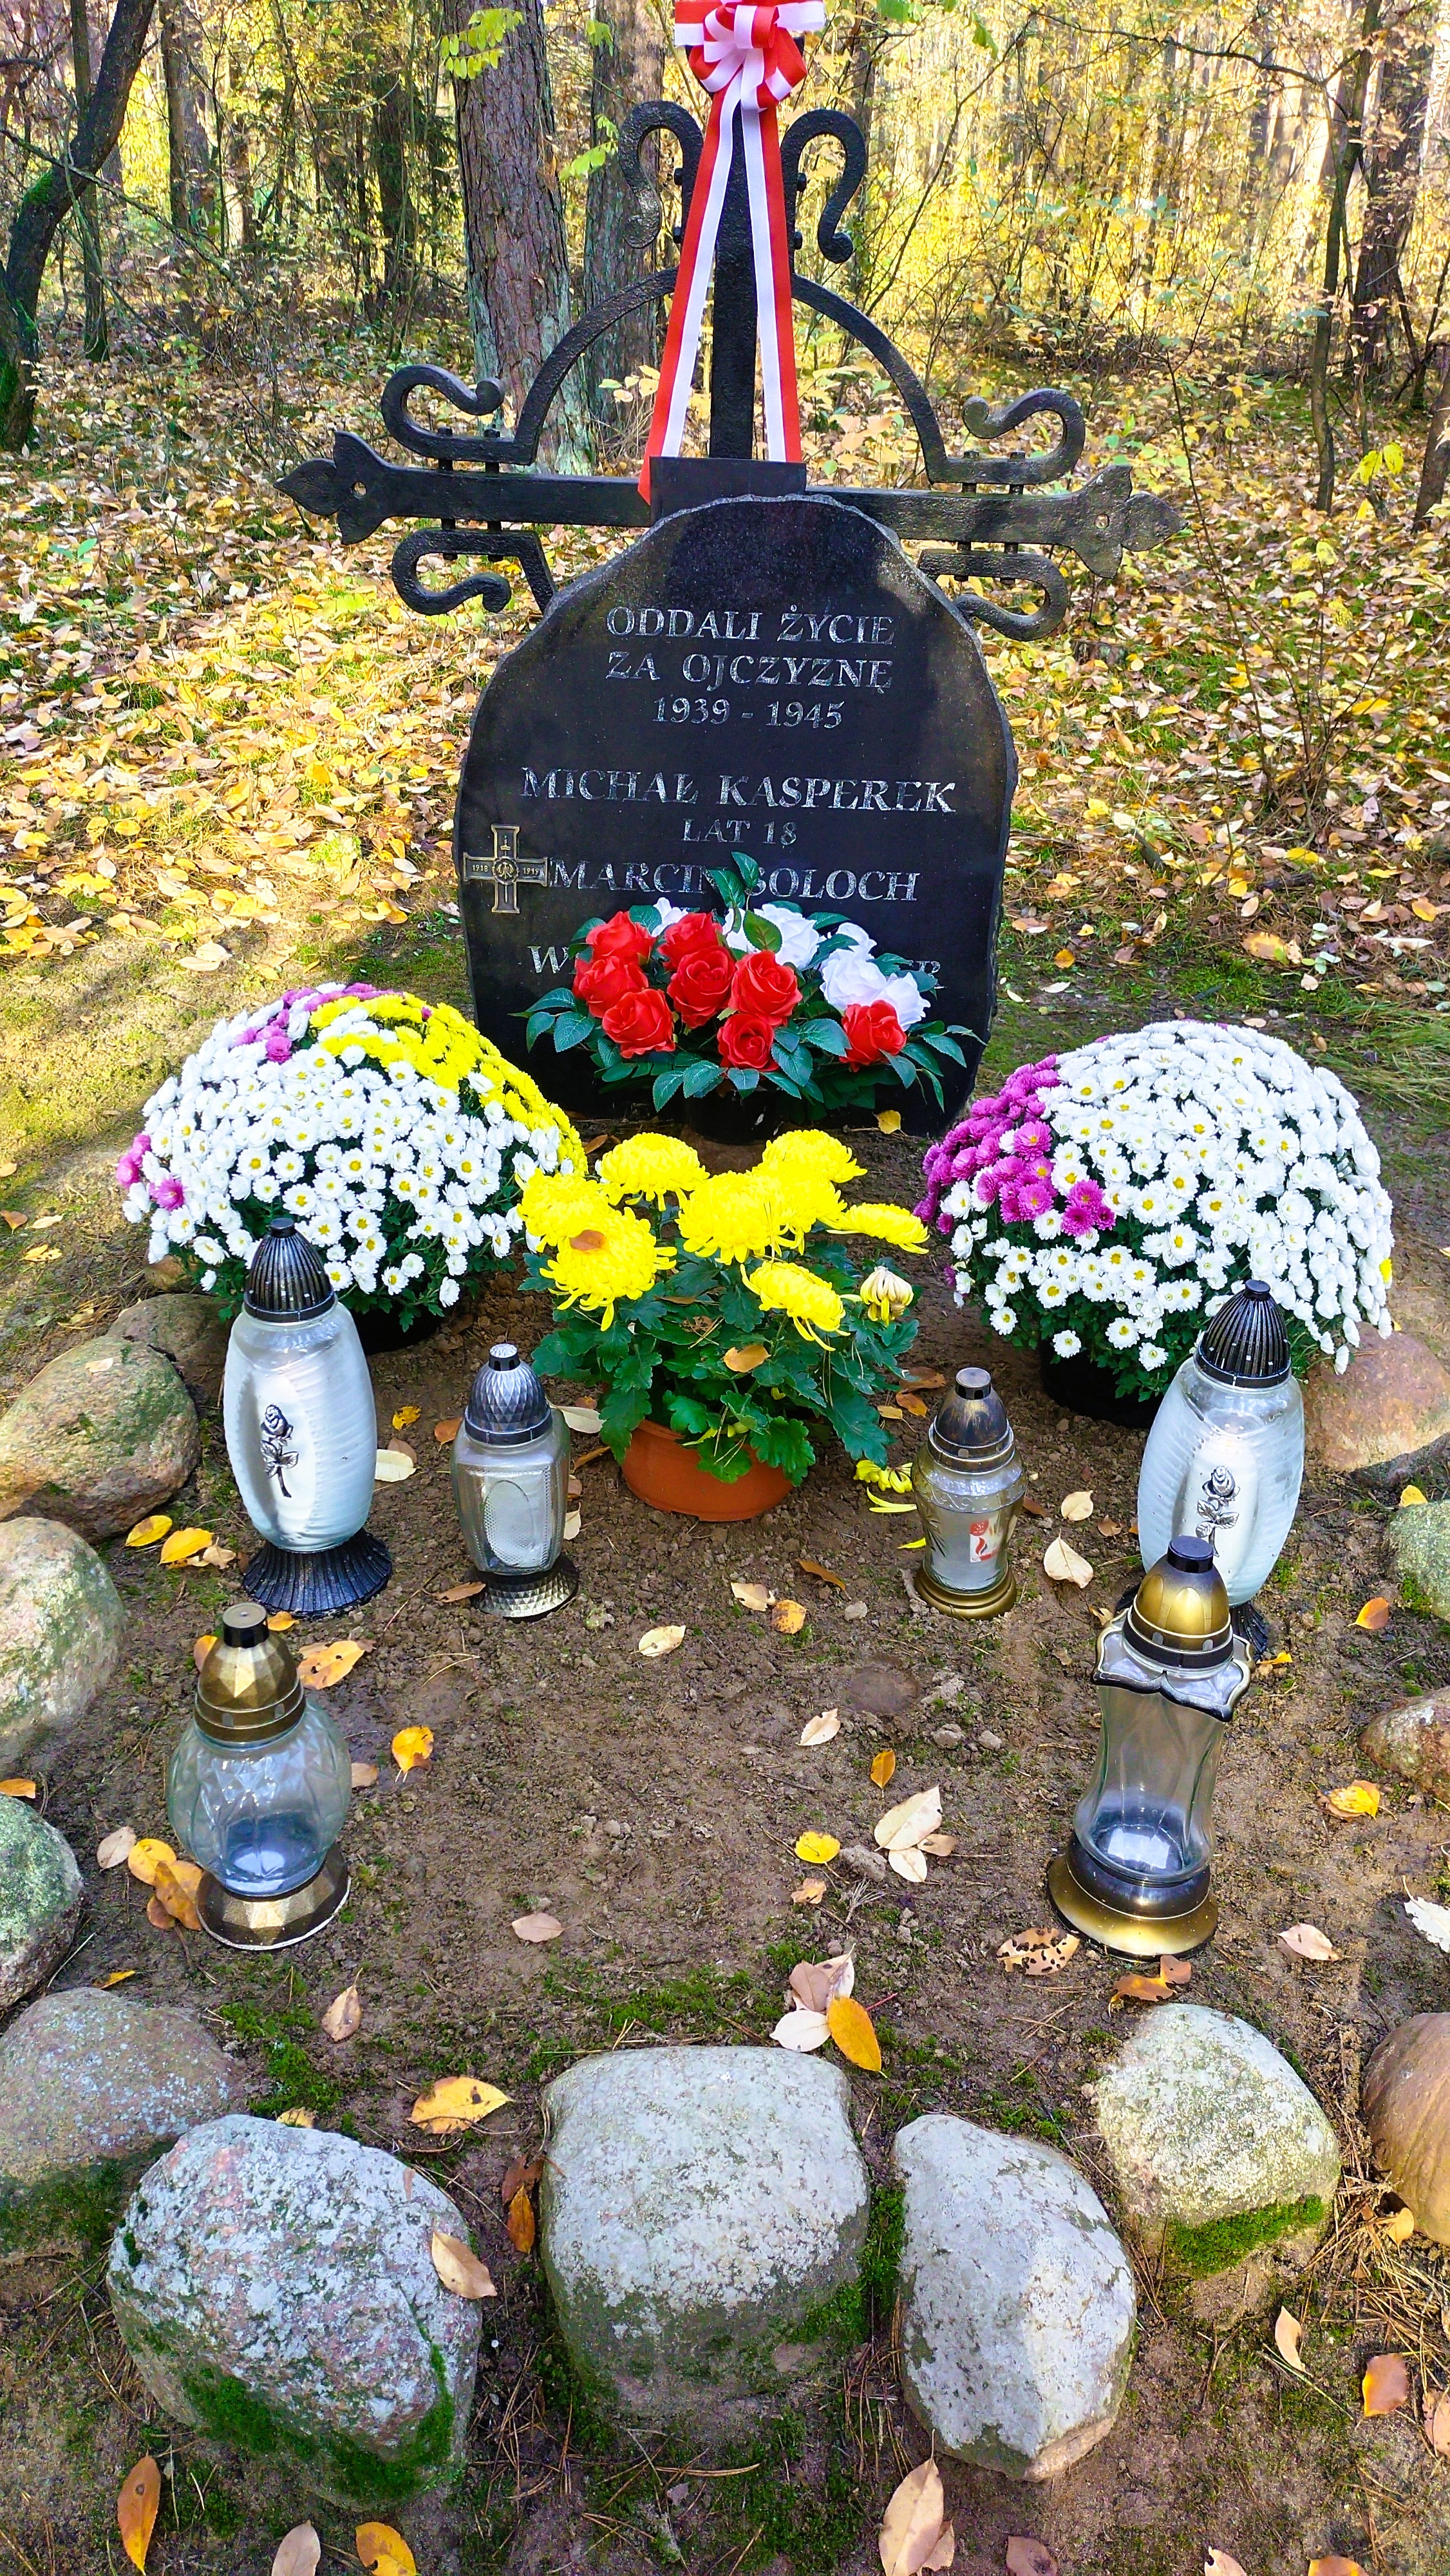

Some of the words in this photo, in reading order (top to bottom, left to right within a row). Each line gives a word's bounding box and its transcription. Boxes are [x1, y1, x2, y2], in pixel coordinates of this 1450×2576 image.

[607, 606, 763, 640] ODDALI
[777, 605, 894, 644] ŻYCIE
[605, 650, 660, 681] ZA
[683, 654, 894, 694] OJCZYZNĘ
[652, 697, 731, 724] 1939
[766, 701, 845, 728] 1945
[520, 767, 699, 804] MICHAŁ
[716, 775, 957, 813] KASPEREK
[682, 819, 750, 843] LAT
[762, 821, 798, 845] 18
[472, 864, 489, 873] 1918
